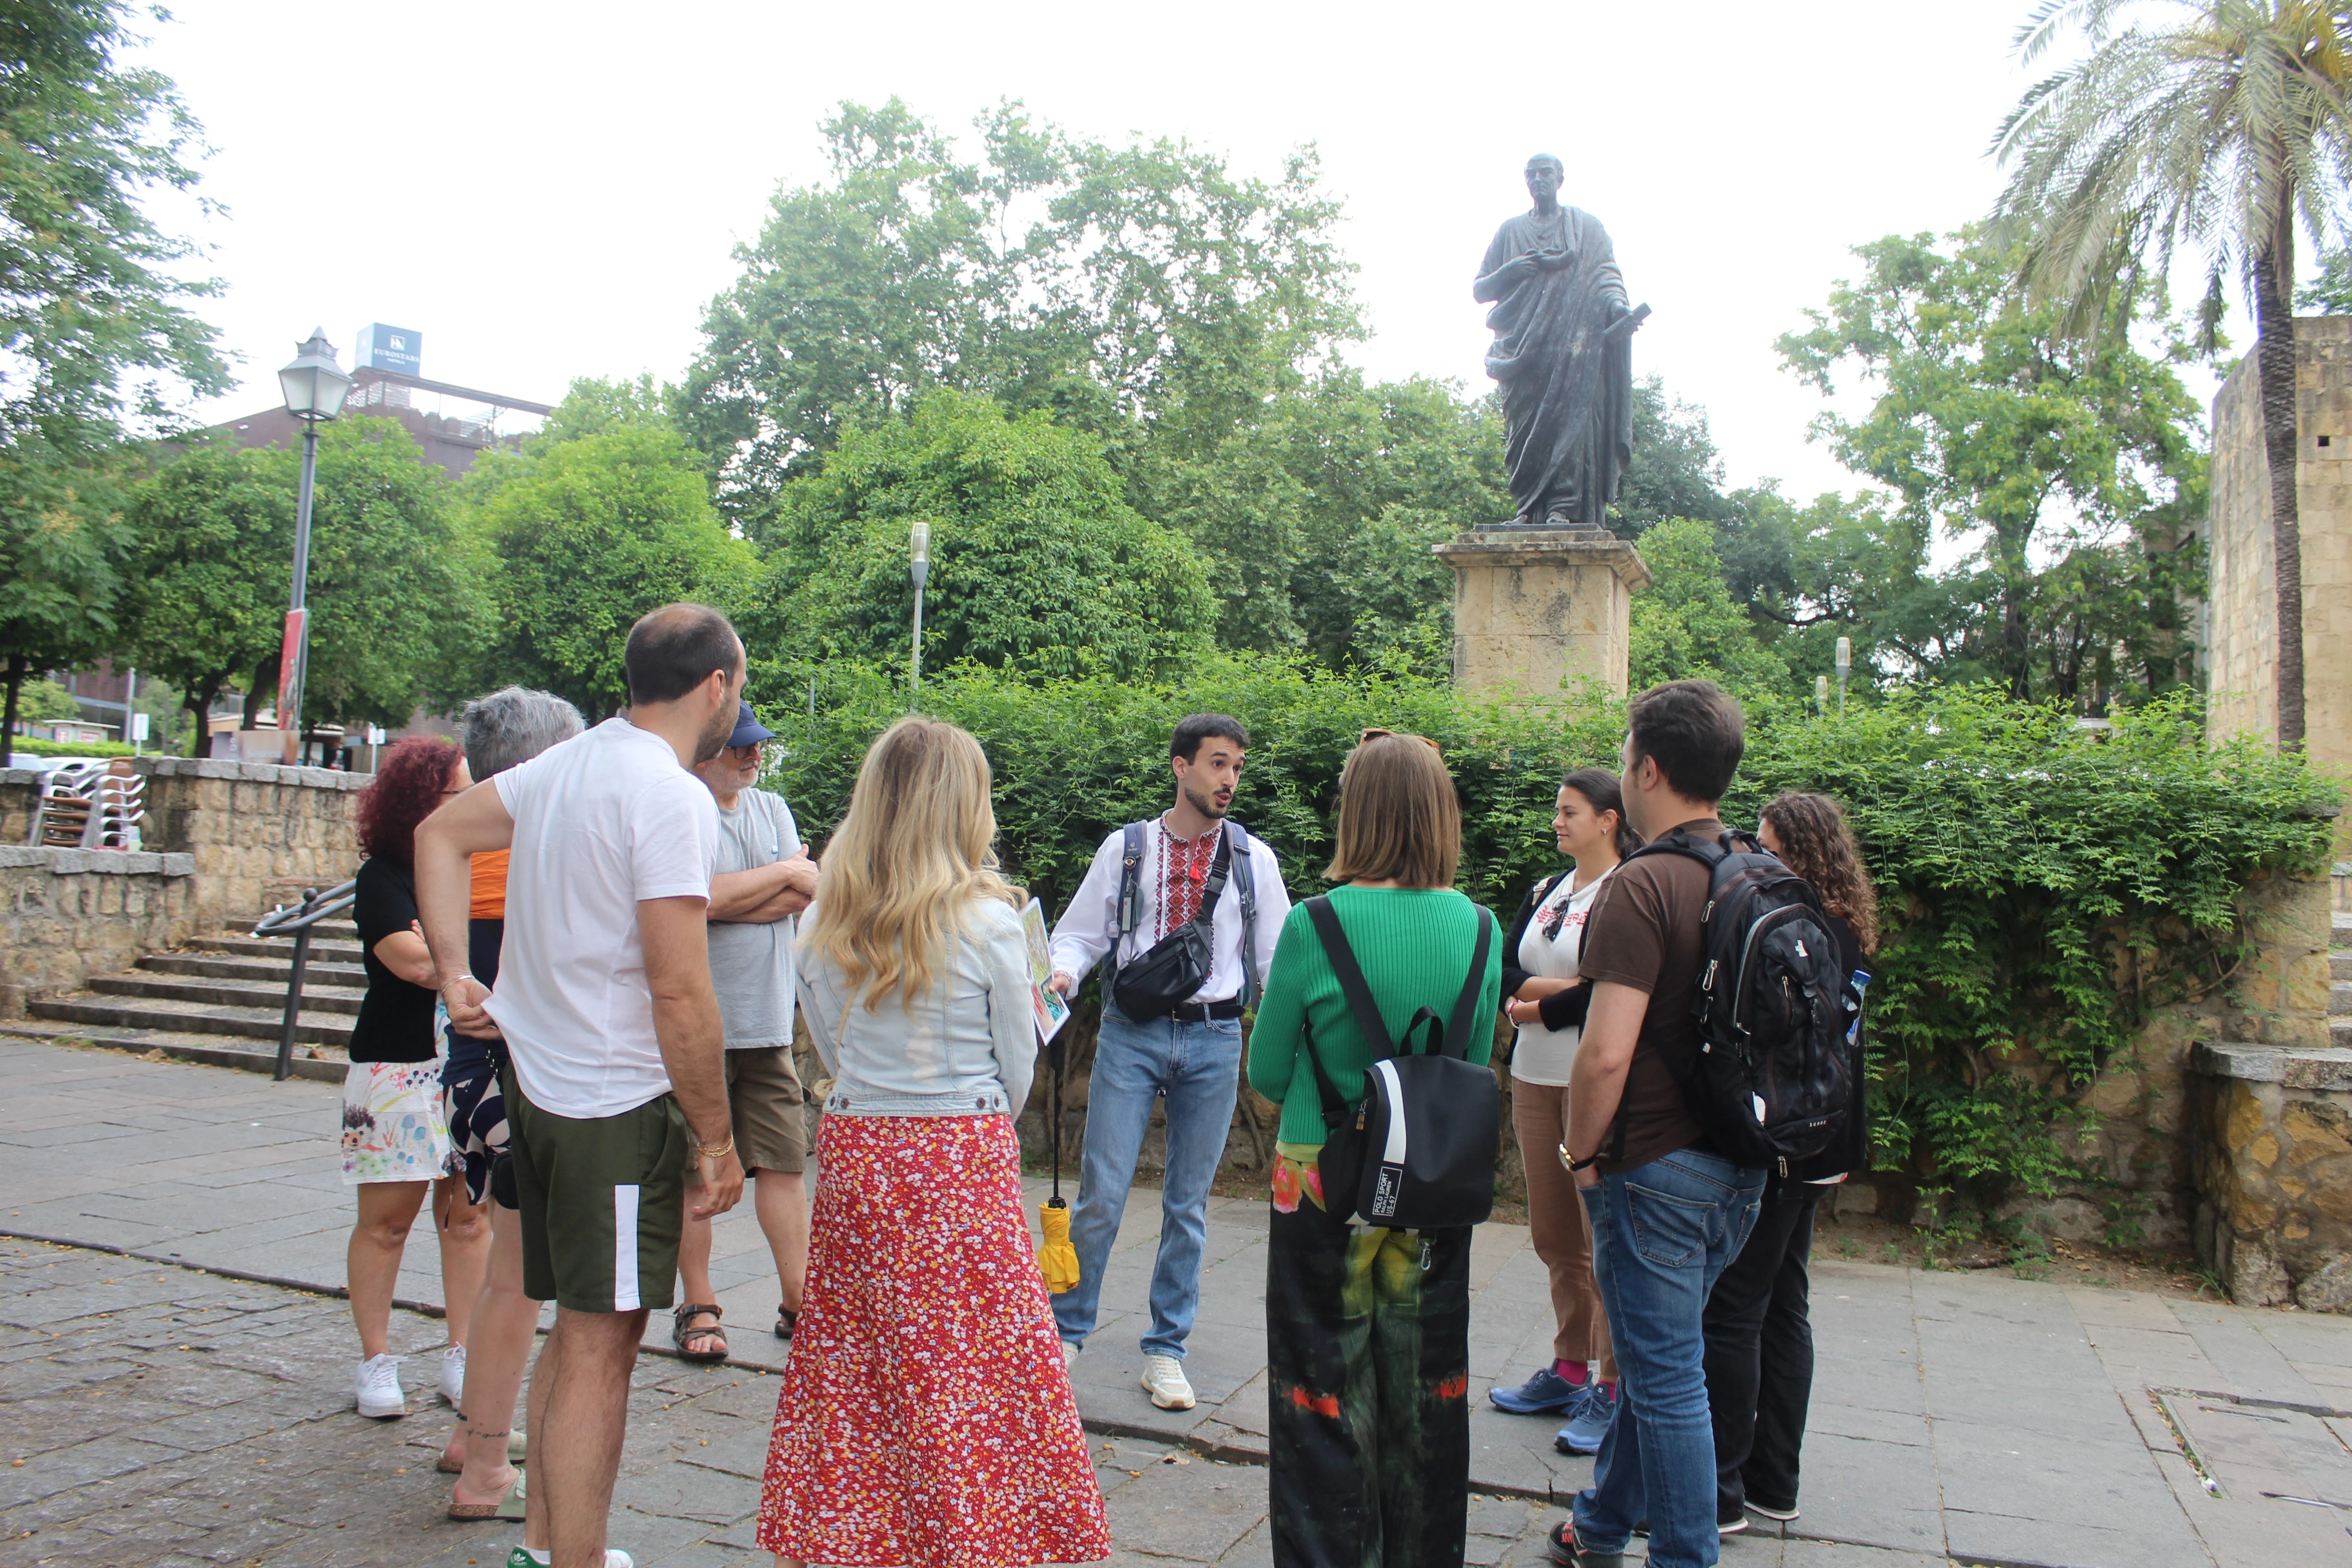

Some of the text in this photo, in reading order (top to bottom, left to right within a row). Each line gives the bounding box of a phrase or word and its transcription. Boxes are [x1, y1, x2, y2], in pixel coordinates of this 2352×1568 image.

[373, 348, 420, 363] EUROSTARS
[1374, 1172, 1388, 1213] POLO SPORT
[1386, 1195, 1395, 1214] US-67
